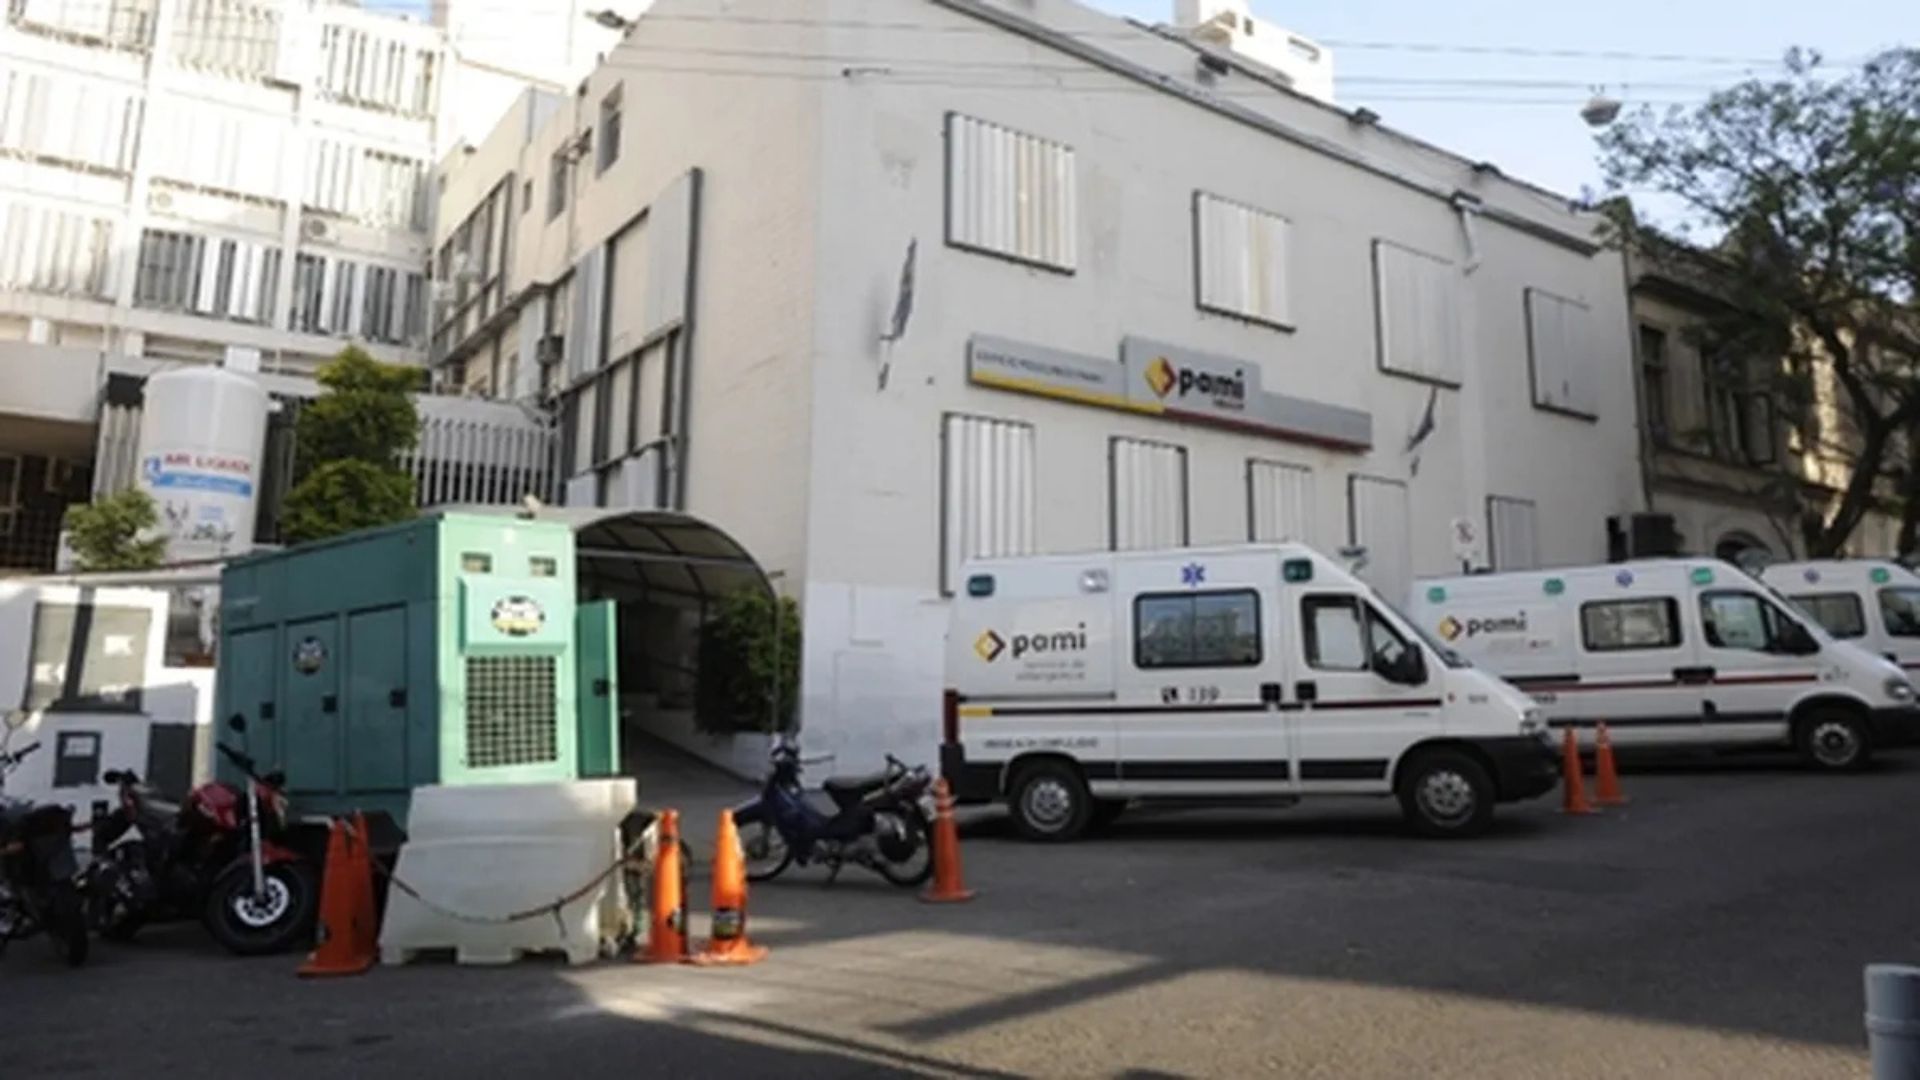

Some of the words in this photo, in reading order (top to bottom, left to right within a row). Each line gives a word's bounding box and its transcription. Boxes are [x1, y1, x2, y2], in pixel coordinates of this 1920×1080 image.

[1179, 367, 1245, 399] pami
[1011, 621, 1086, 658] pami
[1466, 610, 1527, 638] pami
